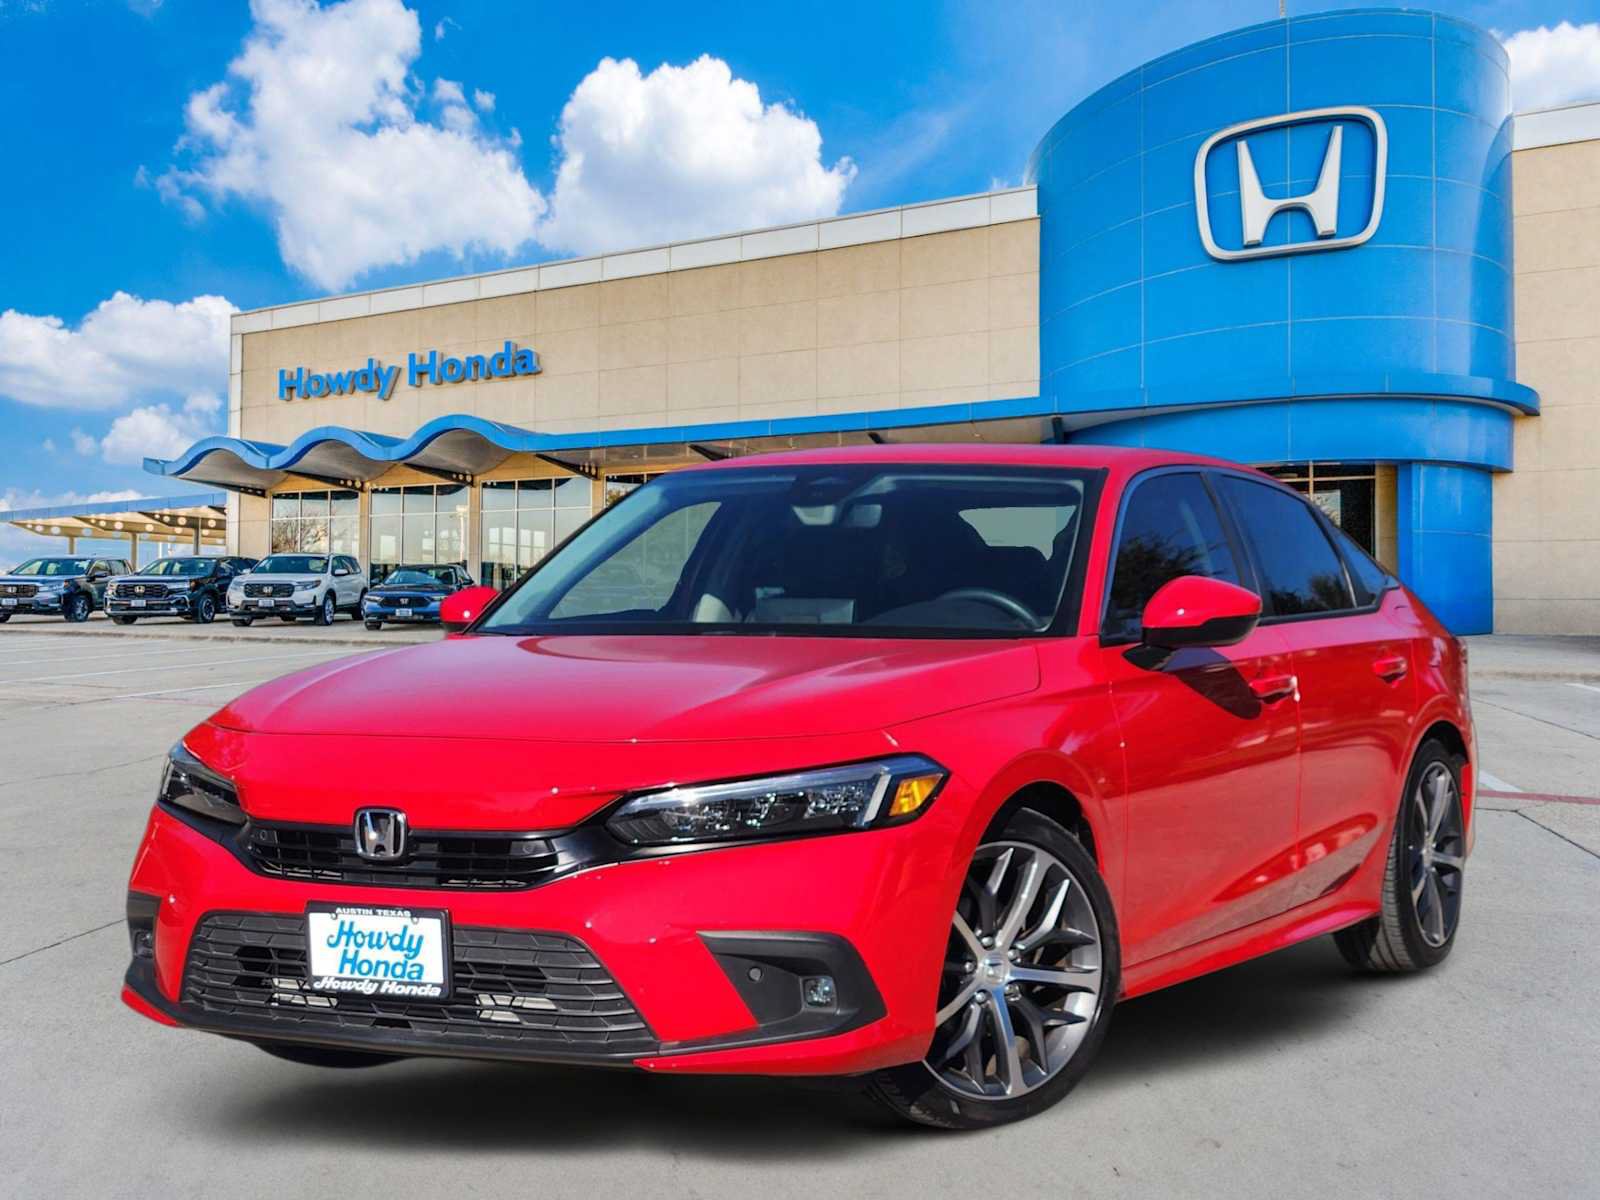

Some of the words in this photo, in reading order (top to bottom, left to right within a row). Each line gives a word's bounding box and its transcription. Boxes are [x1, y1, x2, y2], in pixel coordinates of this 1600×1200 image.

[278, 357, 399, 401] Howdy
[408, 340, 541, 387] Honda
[335, 907, 373, 916] AUSTIN
[375, 908, 411, 918] TEXAS
[326, 919, 424, 960] Howdy
[338, 949, 425, 980] Honda
[313, 976, 379, 995] Howdy
[380, 981, 442, 997] Honda
